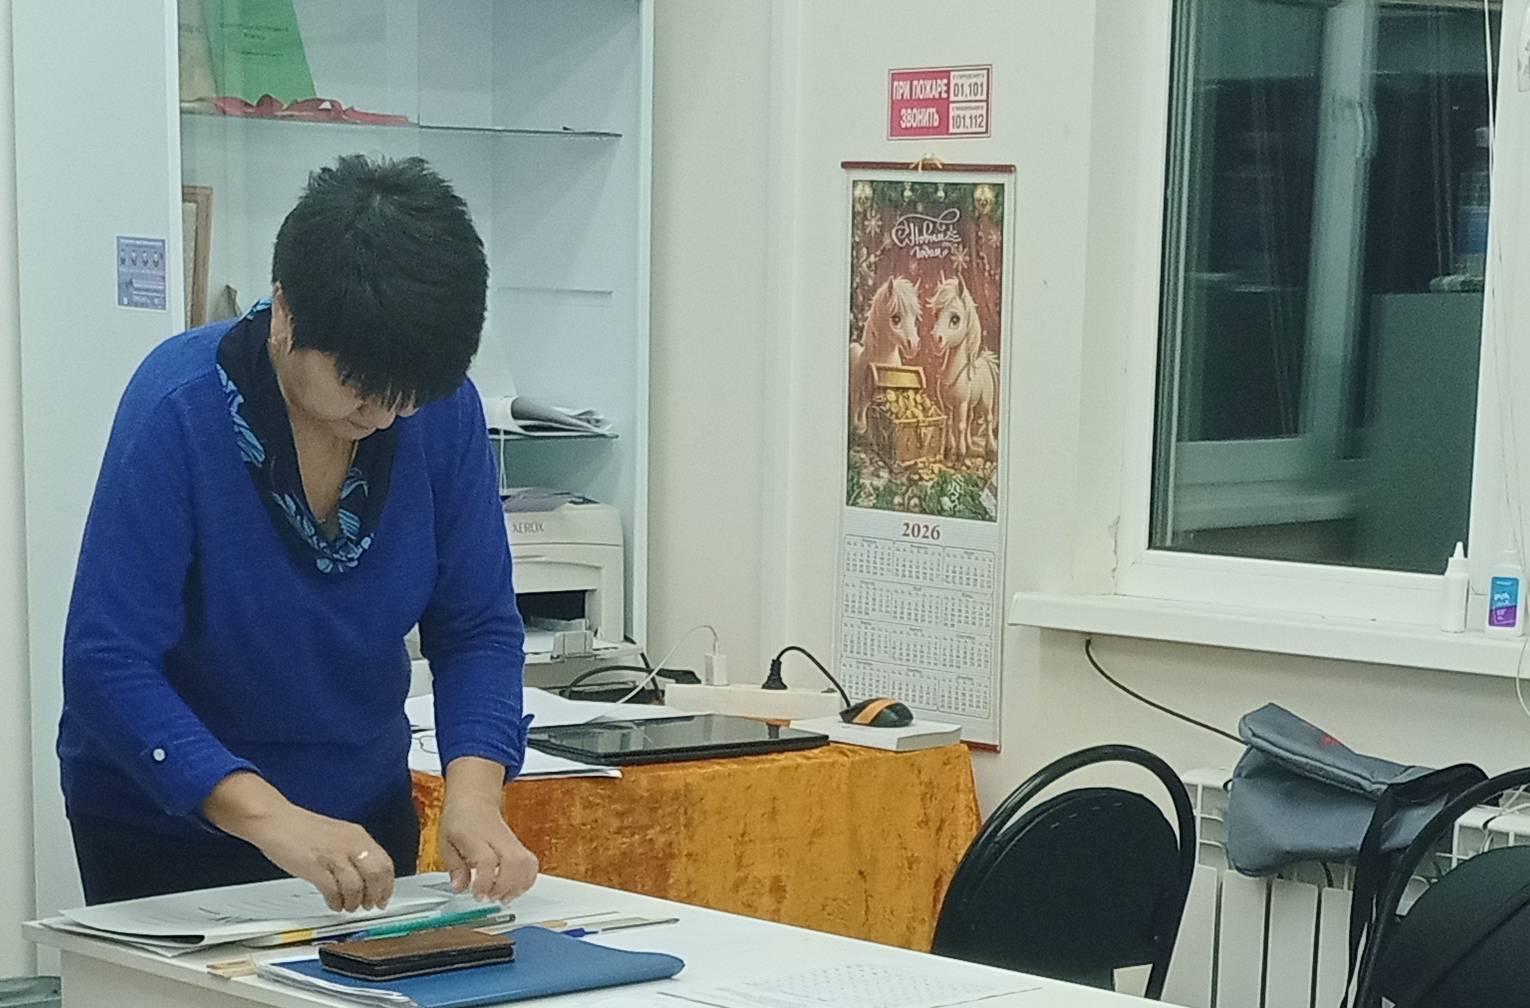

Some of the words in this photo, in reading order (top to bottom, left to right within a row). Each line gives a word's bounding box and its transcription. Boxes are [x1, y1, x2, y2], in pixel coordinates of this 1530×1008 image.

[893, 80, 910, 100] ПРИ
[912, 78, 948, 99] ПОЖАРЕ
[953, 82, 984, 98] 01,101
[900, 107, 940, 129] ЗВОНИТЬ
[512, 521, 544, 534] XEROX
[901, 522, 941, 540] 2026
